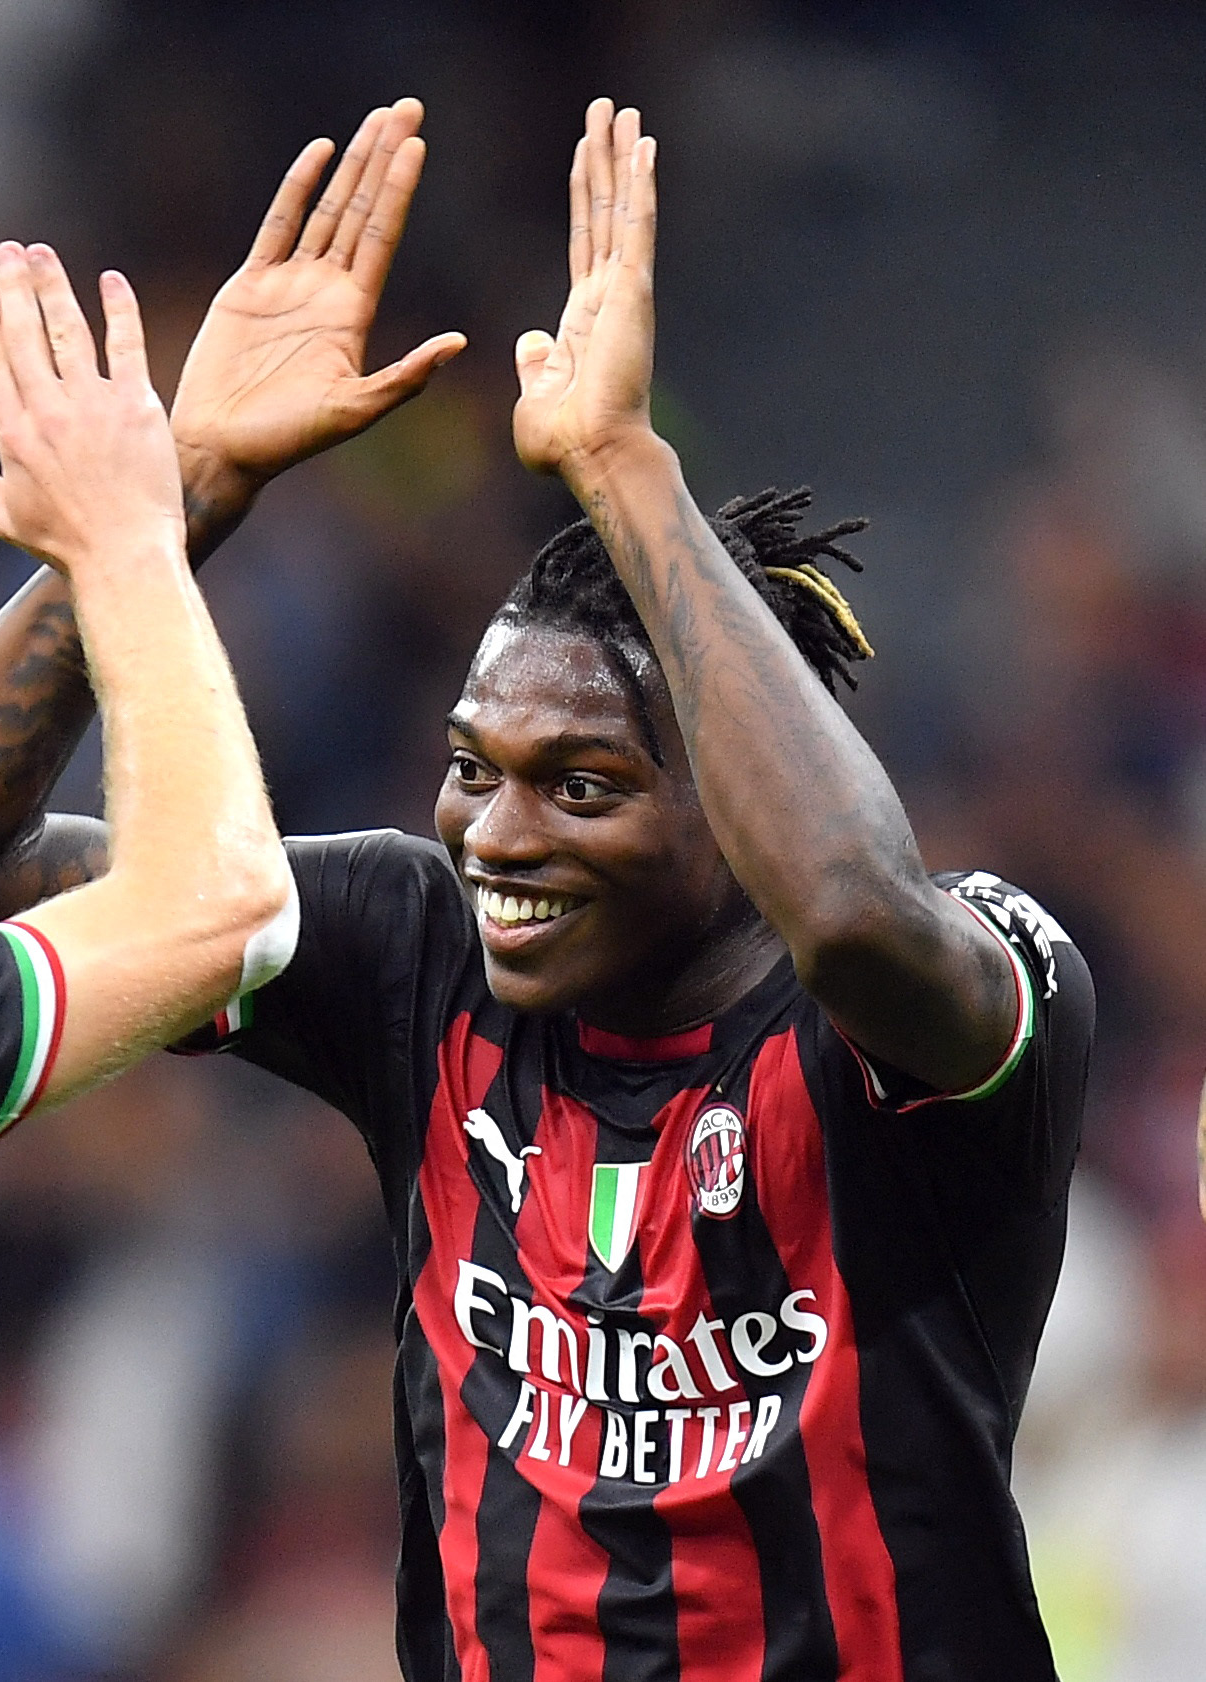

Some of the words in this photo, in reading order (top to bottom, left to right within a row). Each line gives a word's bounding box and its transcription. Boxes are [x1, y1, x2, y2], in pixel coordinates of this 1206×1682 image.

[699, 1111, 737, 1139] ACM
[706, 1187, 739, 1207] 1899
[453, 1258, 829, 1404] Emirates
[497, 1380, 589, 1467] FLY
[599, 1394, 782, 1485] BETTER
